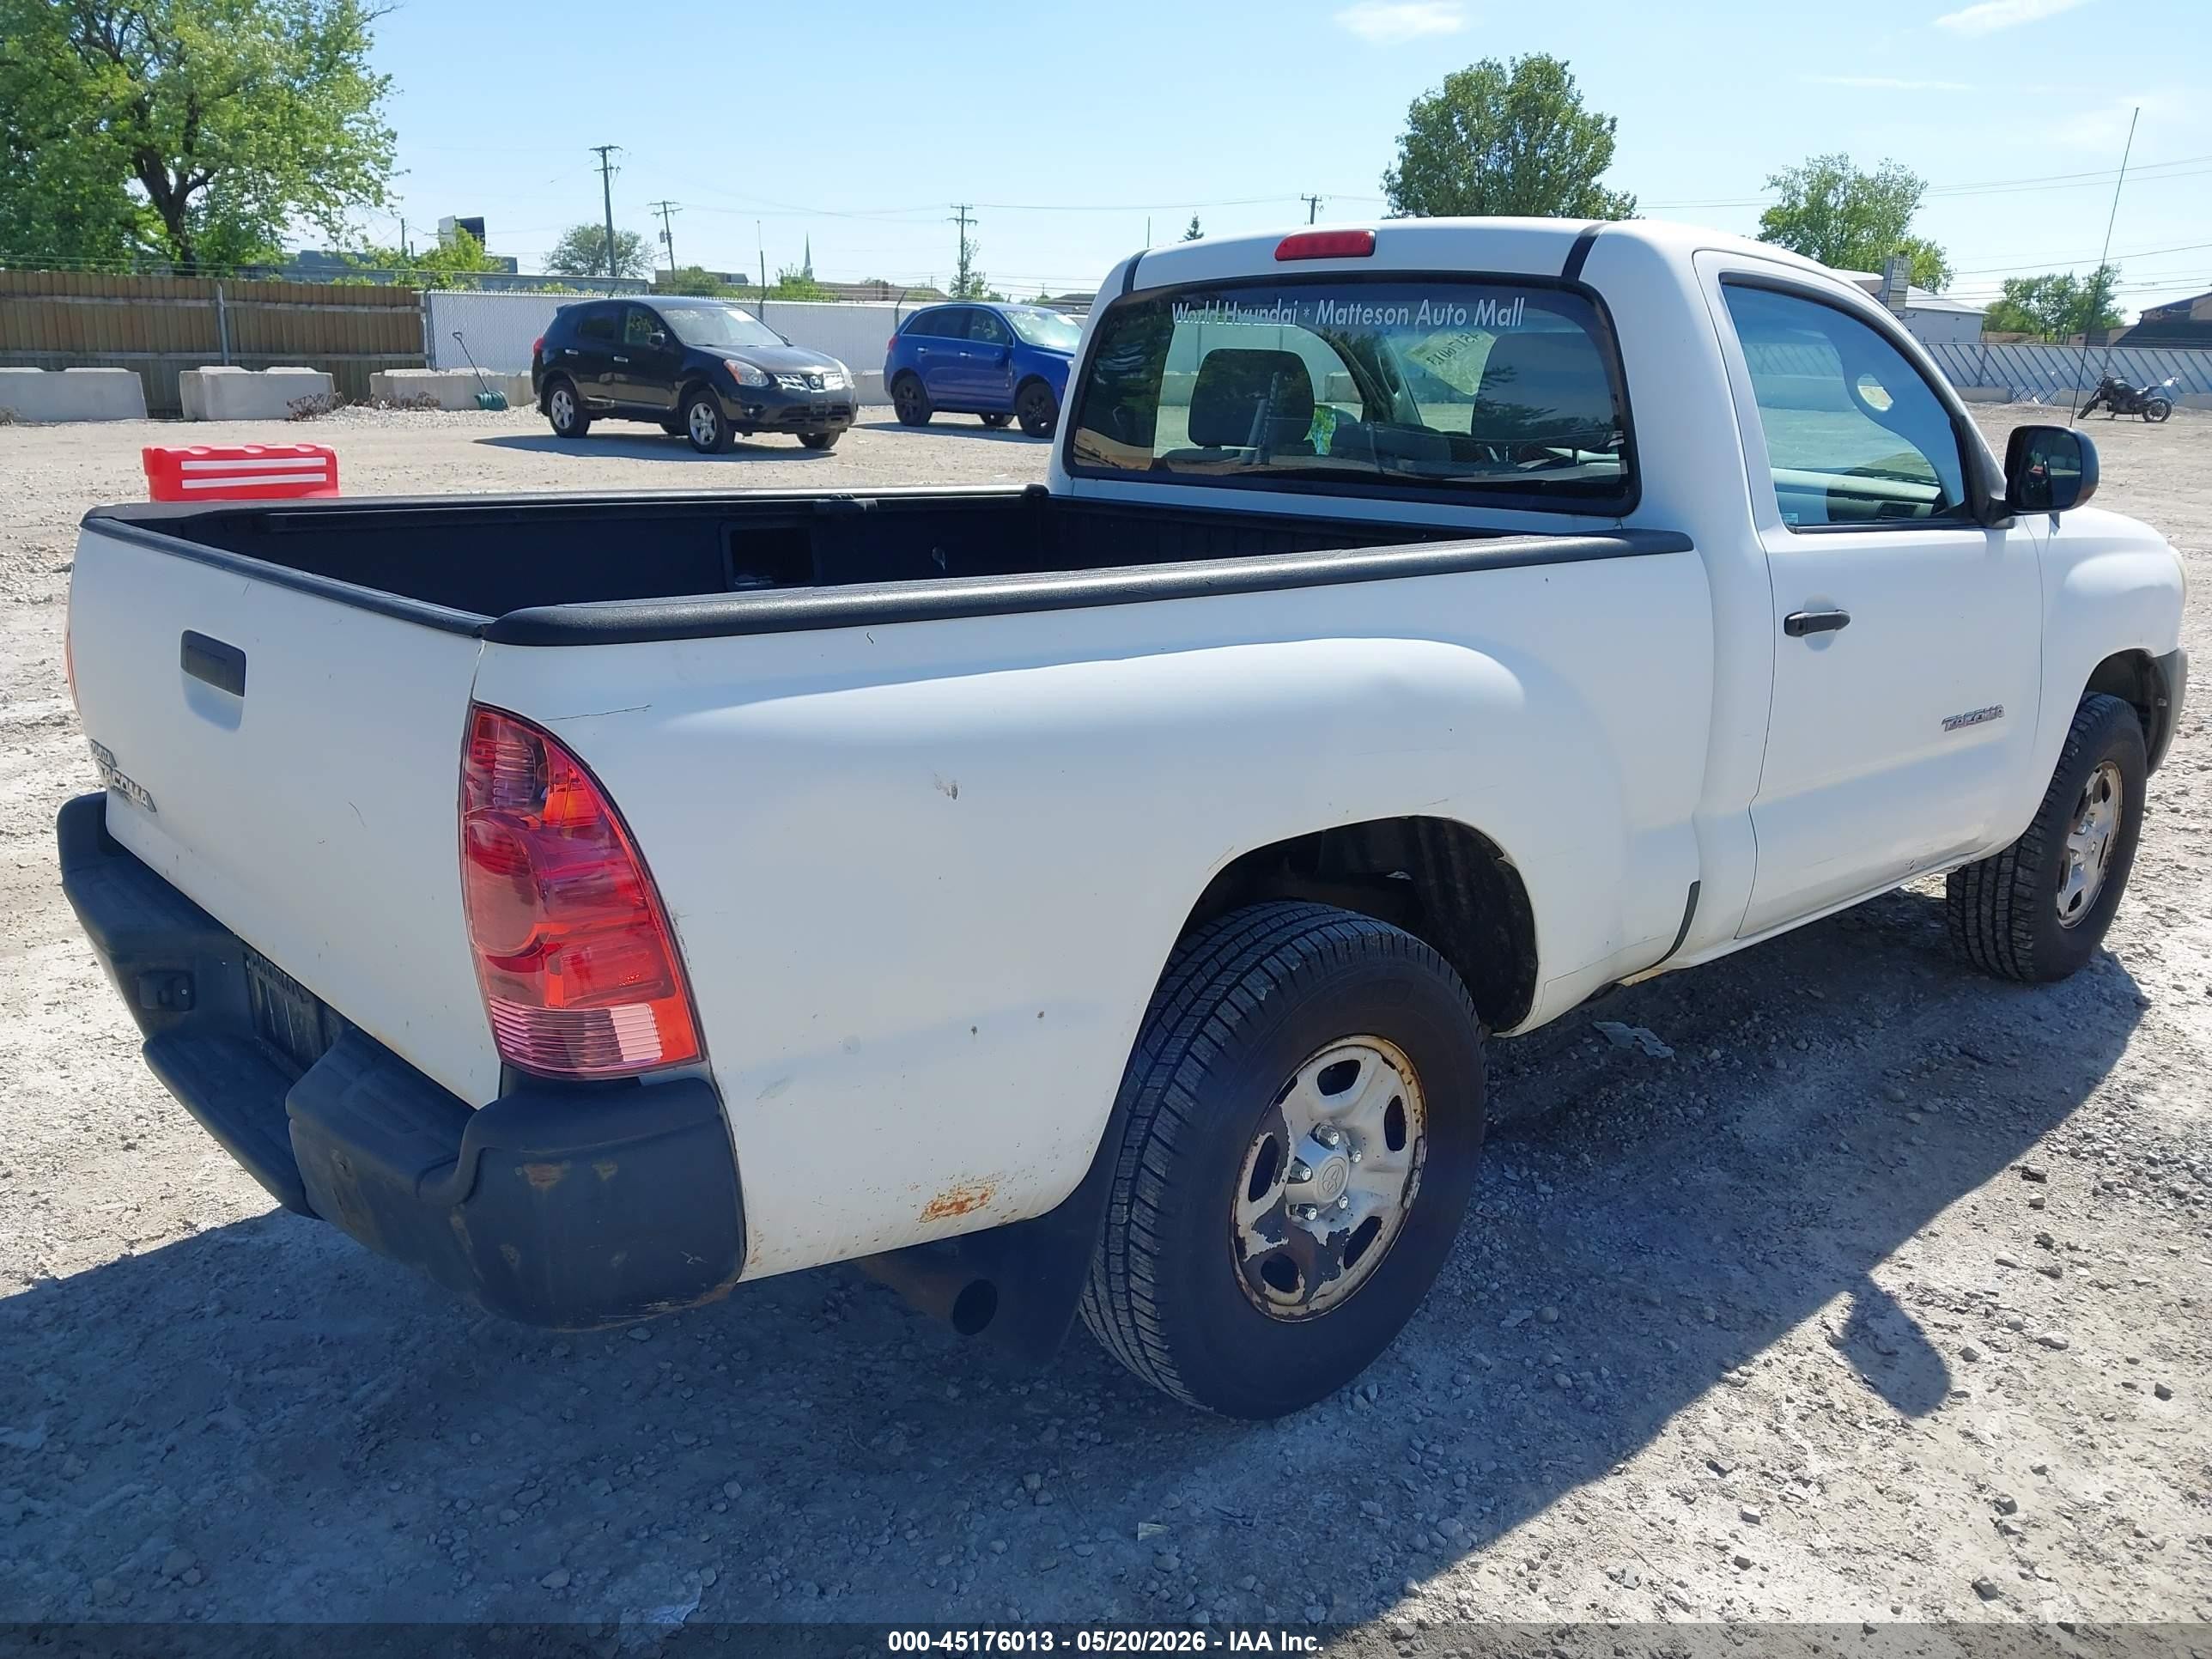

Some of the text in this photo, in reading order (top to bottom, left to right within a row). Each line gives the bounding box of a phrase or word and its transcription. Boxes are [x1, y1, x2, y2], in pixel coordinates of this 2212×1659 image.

[1171, 299, 1219, 324] World
[1224, 298, 1298, 325] Hyundai
[1315, 299, 1410, 325] Matteson
[1414, 298, 1468, 326] Auto
[1474, 297, 1526, 327] Mall
[1942, 704, 2005, 732] TACOMA
